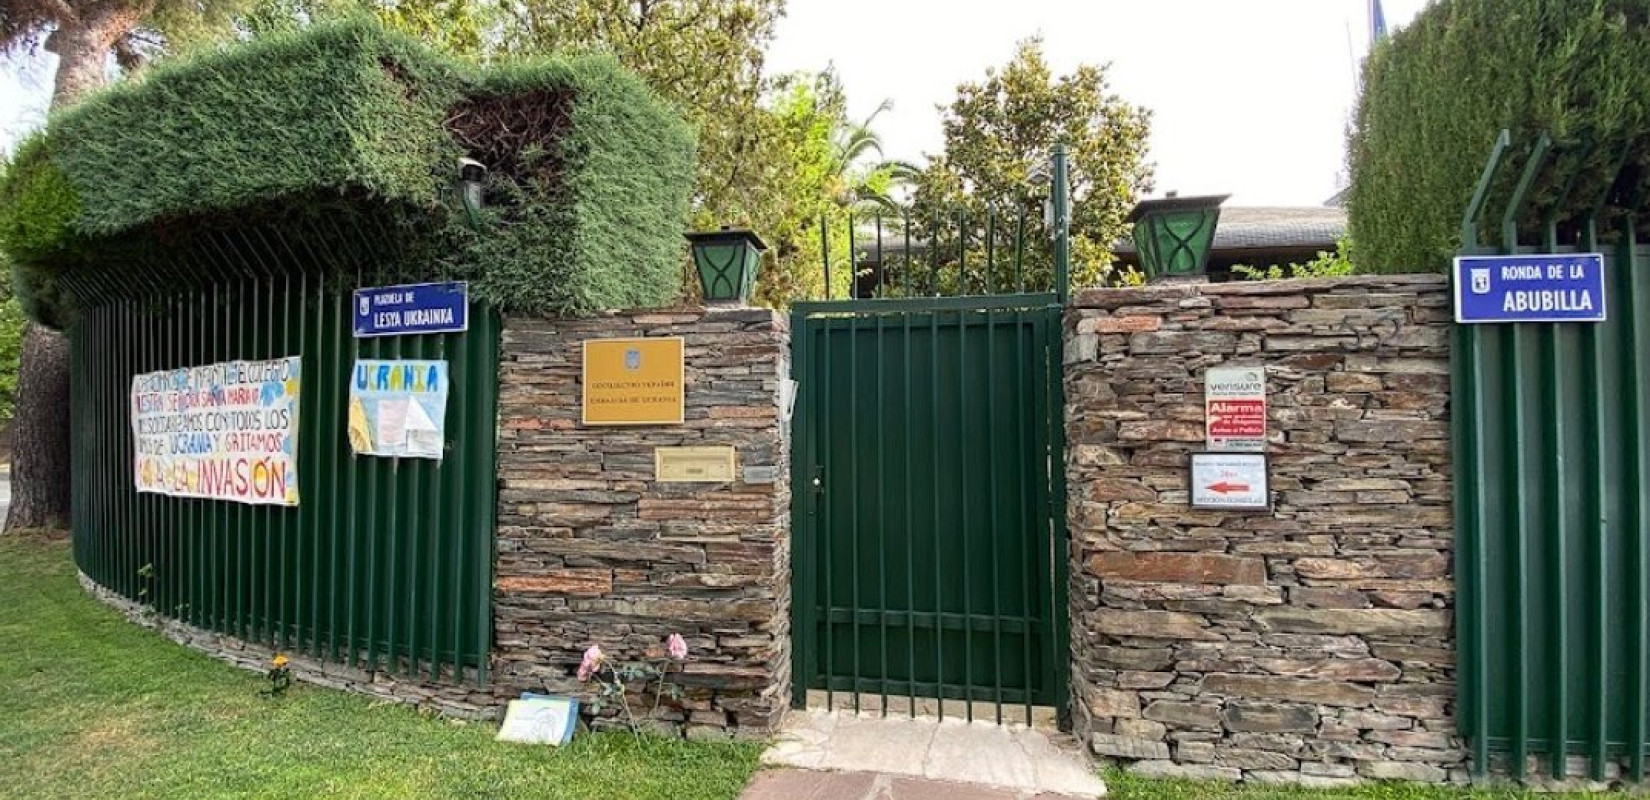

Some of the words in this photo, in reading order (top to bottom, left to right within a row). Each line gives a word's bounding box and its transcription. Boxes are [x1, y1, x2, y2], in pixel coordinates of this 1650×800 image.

[1501, 265, 1542, 281] RONDA
[1547, 264, 1563, 279] DE
[1569, 264, 1585, 279] LA
[405, 291, 415, 304] DE
[1503, 289, 1593, 312] ABUBILLA
[374, 311, 401, 328] LESYA
[404, 308, 454, 326] UKRAINKA
[356, 364, 439, 393] UCRANIA
[1210, 383, 1262, 391] verisure
[1211, 402, 1263, 414] Alarma
[265, 408, 289, 430] LOS
[225, 431, 283, 453] GRITAMOS
[195, 455, 287, 499] INVASIÓN
